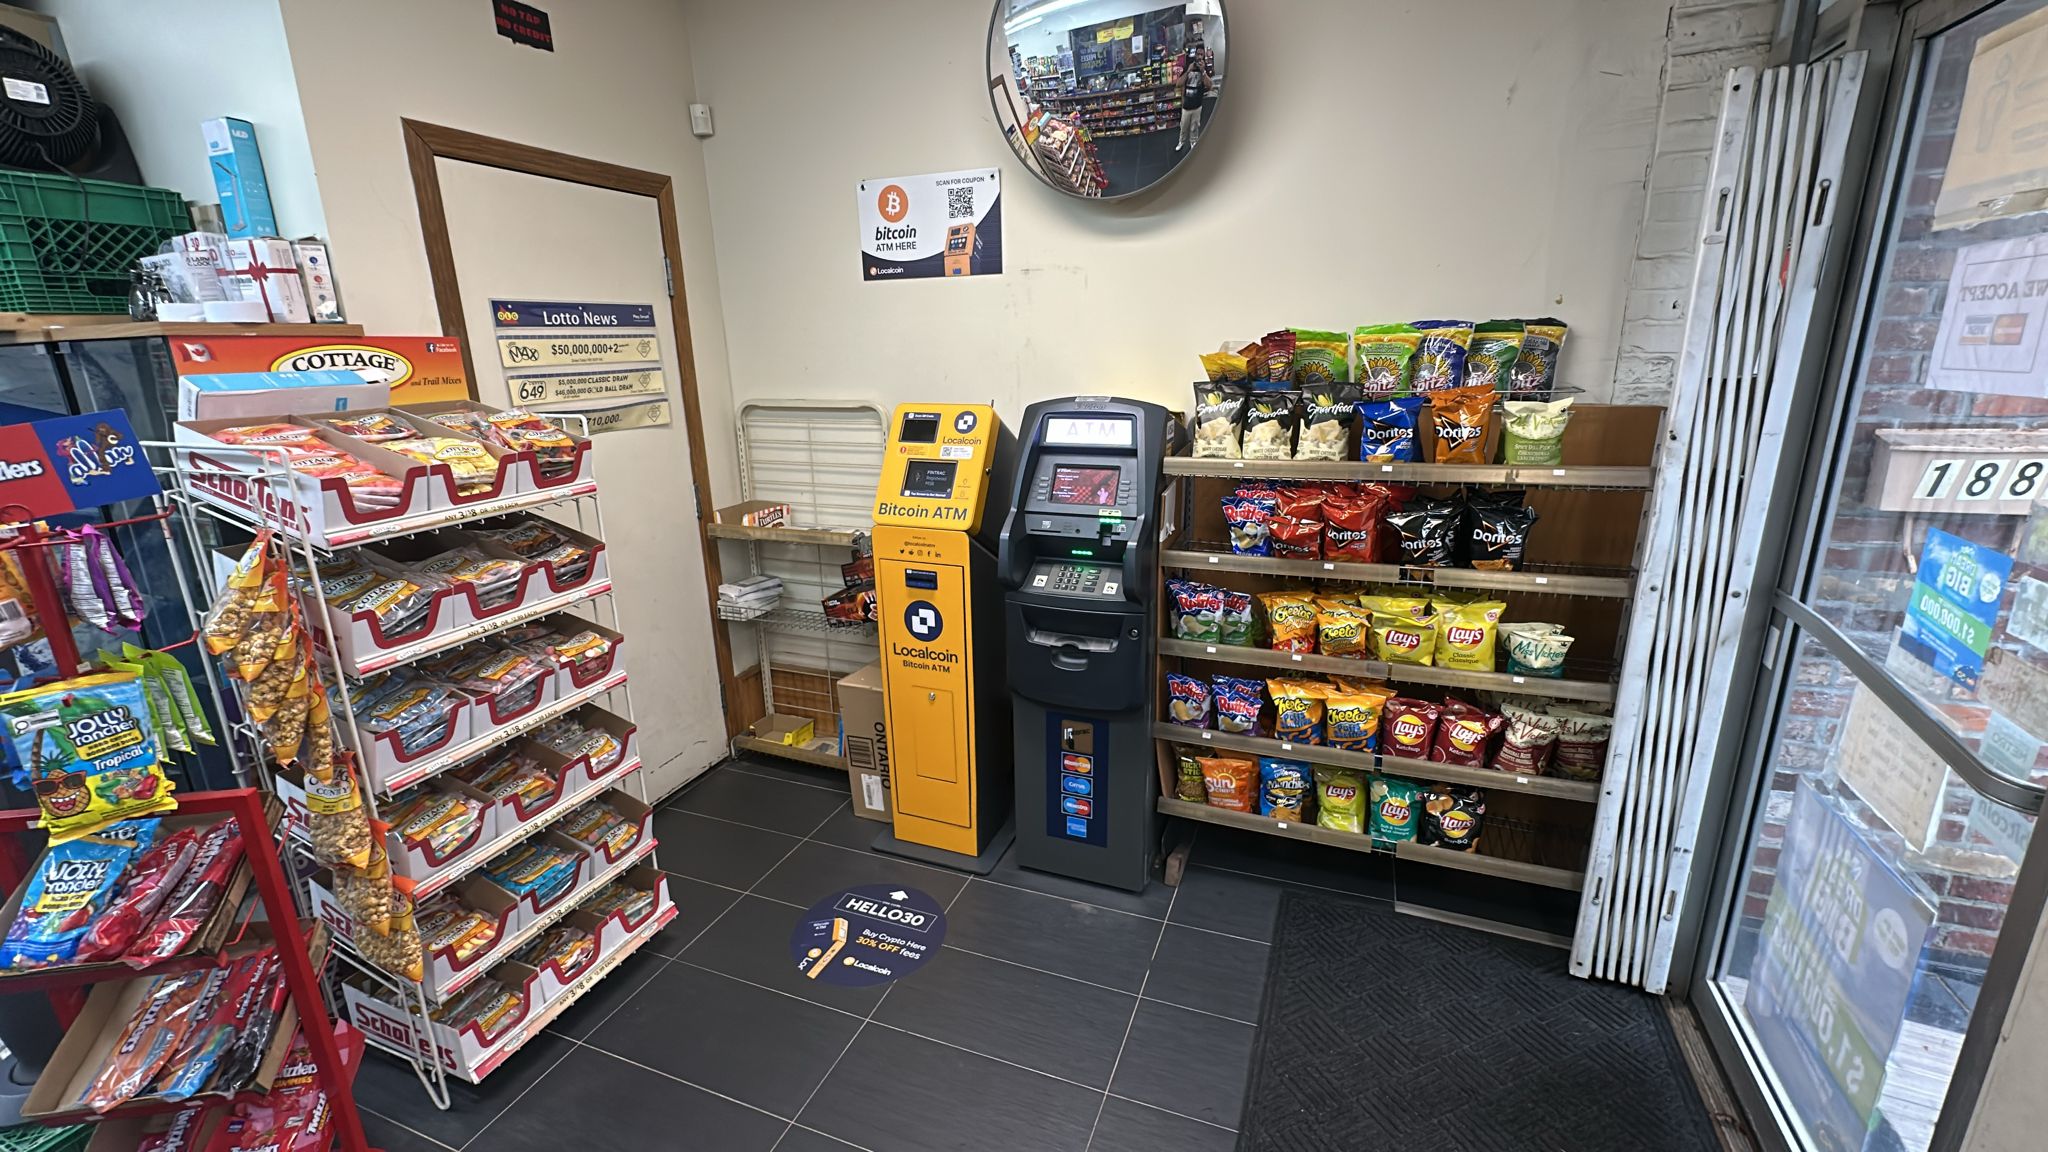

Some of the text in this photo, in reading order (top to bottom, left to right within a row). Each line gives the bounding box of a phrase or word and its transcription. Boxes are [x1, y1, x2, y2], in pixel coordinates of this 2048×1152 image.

[875, 225, 917, 241] bitcoin
[876, 242, 917, 252] ATM HERE
[877, 266, 904, 274] Localcoin
[543, 311, 618, 326] Lotto News
[292, 352, 396, 372] COTTAGE
[422, 376, 440, 386] Trail
[441, 376, 462, 386] Mixes
[588, 376, 611, 384] CLASSIC
[520, 382, 544, 400] 649
[605, 385, 618, 393] BALL
[1306, 404, 1354, 420] Smartfood
[1066, 422, 1116, 437] ATM
[1368, 428, 1413, 440] Doritos
[942, 436, 982, 446] Localcoin
[878, 502, 968, 521] Bitcoin ATM
[1473, 529, 1522, 544] Doritos
[1274, 605, 1312, 624] Cheetos
[1388, 631, 1420, 648] Lay's
[1450, 626, 1482, 644] Lay's
[893, 642, 958, 663] Localcoin
[903, 660, 950, 674] Bitcoin ATM
[70, 707, 125, 738] JOLLY
[76, 719, 136, 747] rancher
[1394, 722, 1425, 740] Lay's
[874, 722, 890, 790] ONTARIO
[1396, 744, 1421, 753] Ketchup
[1448, 747, 1473, 758] Ketchup
[94, 746, 144, 772] Tropical
[1204, 777, 1232, 792] Sun
[1328, 785, 1356, 798] Lay's
[1382, 802, 1410, 820] Lay's
[1443, 818, 1474, 830] Lay's
[846, 898, 925, 927] HELLO30
[862, 928, 927, 951] Buy Crypto Here
[856, 936, 921, 960] 30% OFF fees
[853, 959, 892, 976] Localcoin
